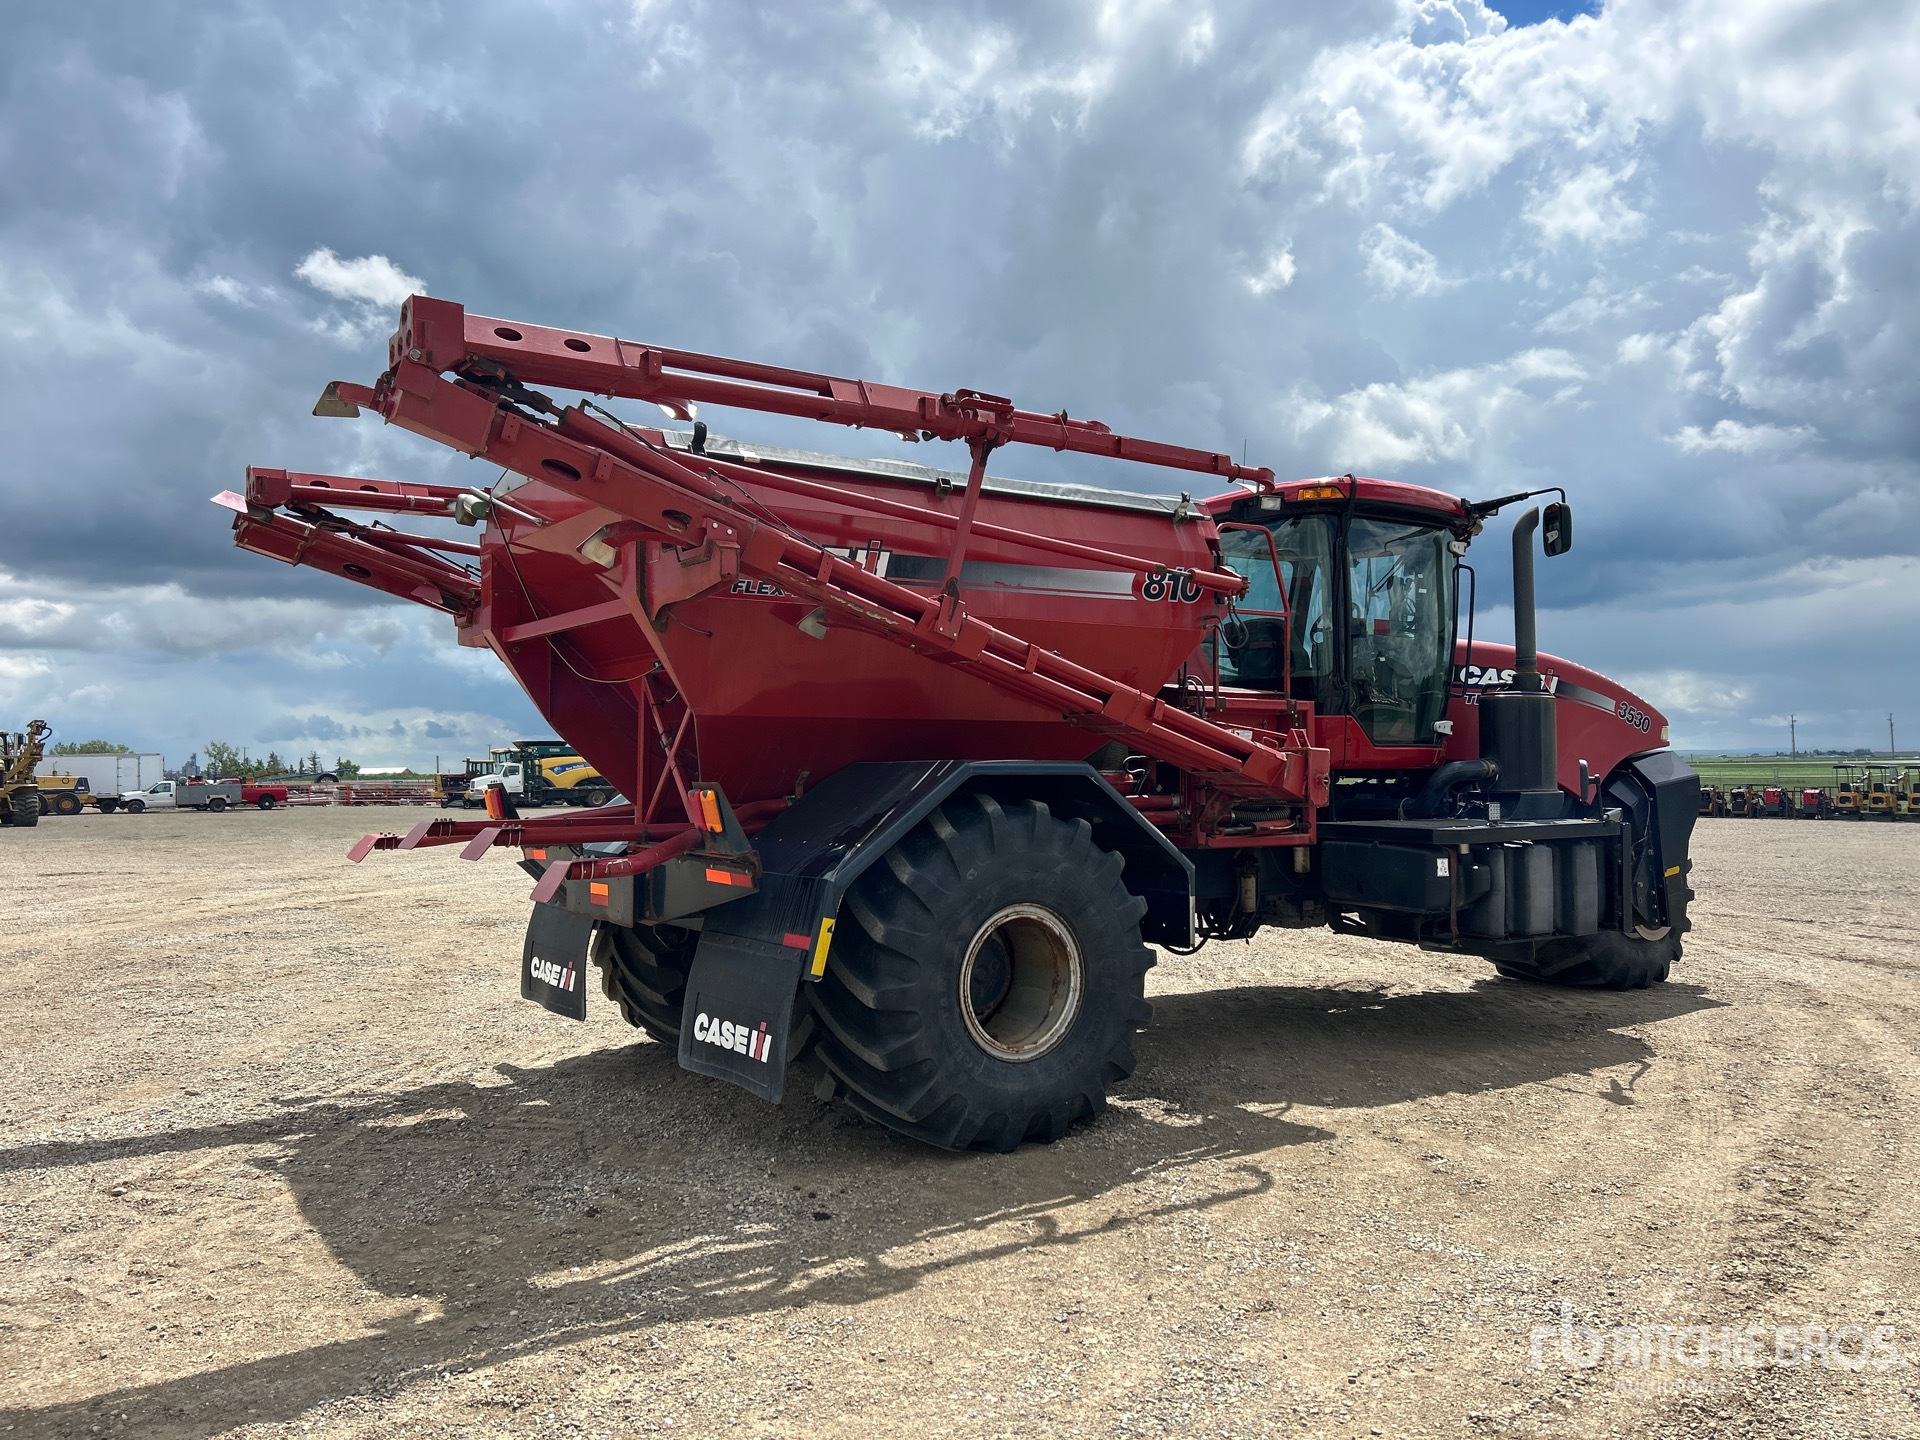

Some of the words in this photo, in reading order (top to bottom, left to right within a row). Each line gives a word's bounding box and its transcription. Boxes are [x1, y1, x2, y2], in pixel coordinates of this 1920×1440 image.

[1142, 567, 1203, 604] 810
[1460, 665, 1517, 685] CAS
[1618, 701, 1651, 734] 3530
